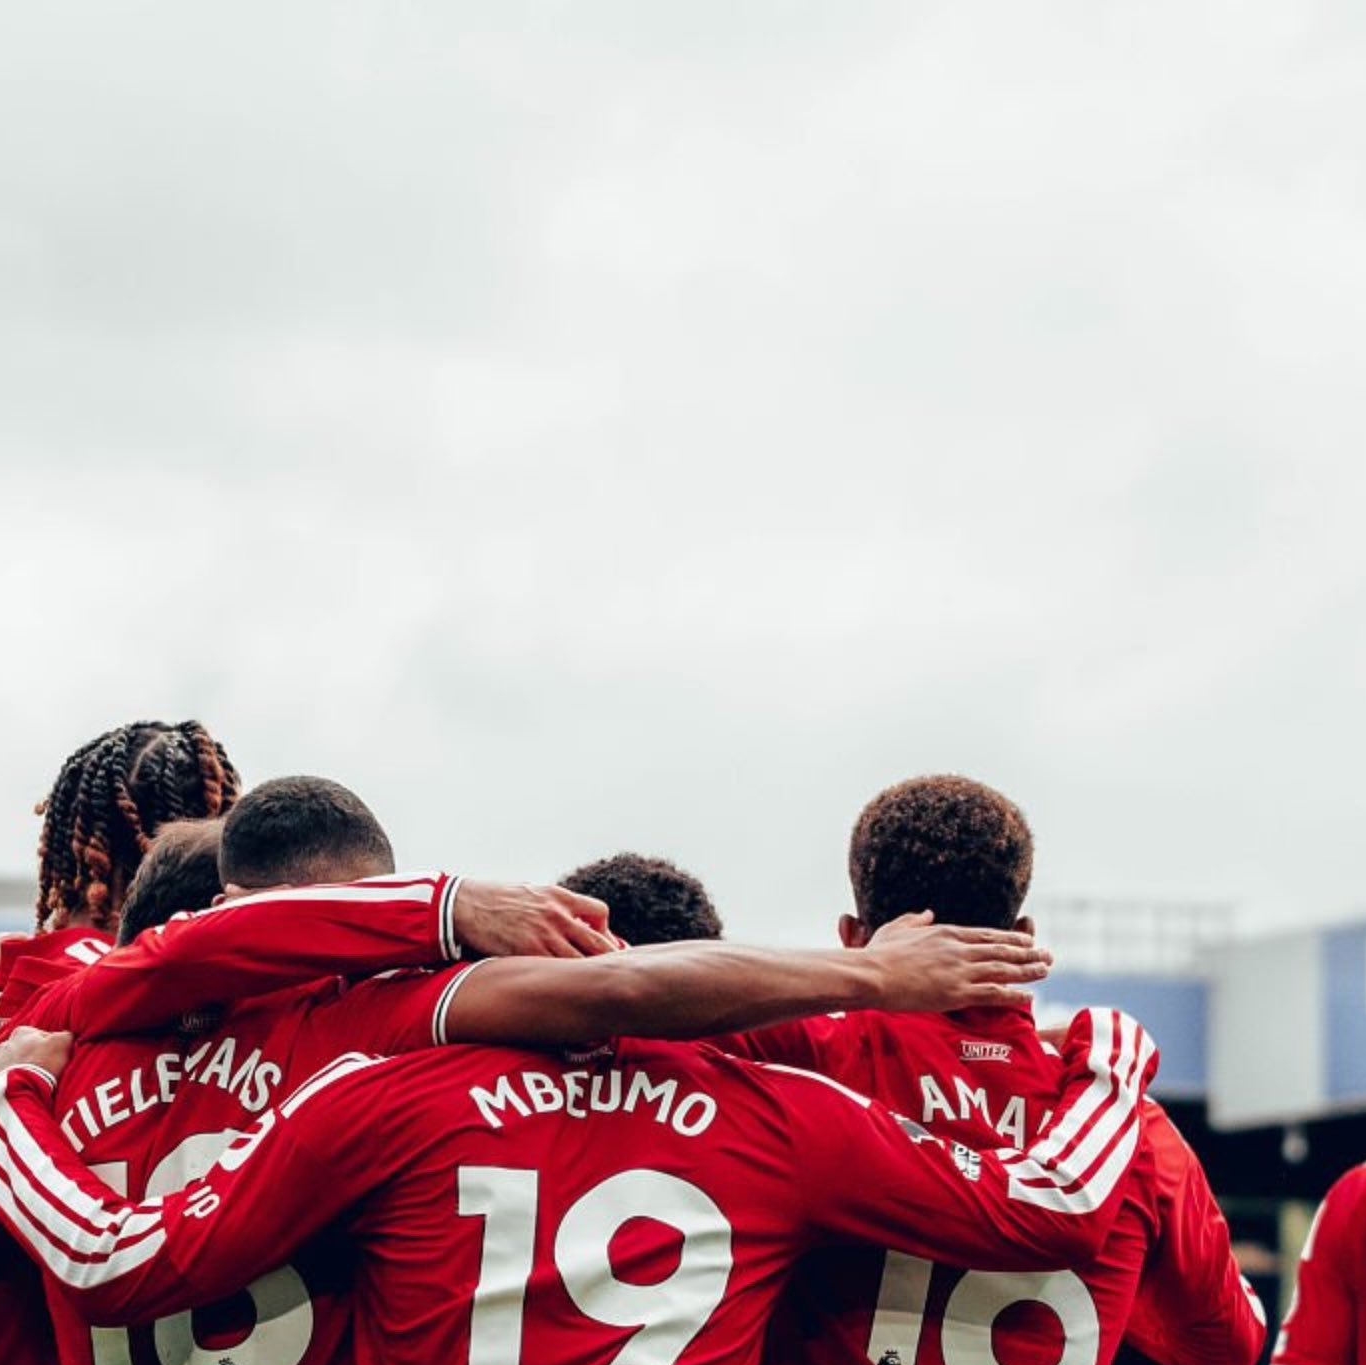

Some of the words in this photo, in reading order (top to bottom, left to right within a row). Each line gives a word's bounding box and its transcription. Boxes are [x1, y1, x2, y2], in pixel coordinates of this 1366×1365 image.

[962, 1044, 1010, 1058] UNITED
[469, 1069, 718, 1138] MBEUMO
[919, 1074, 1054, 1152] AMA
